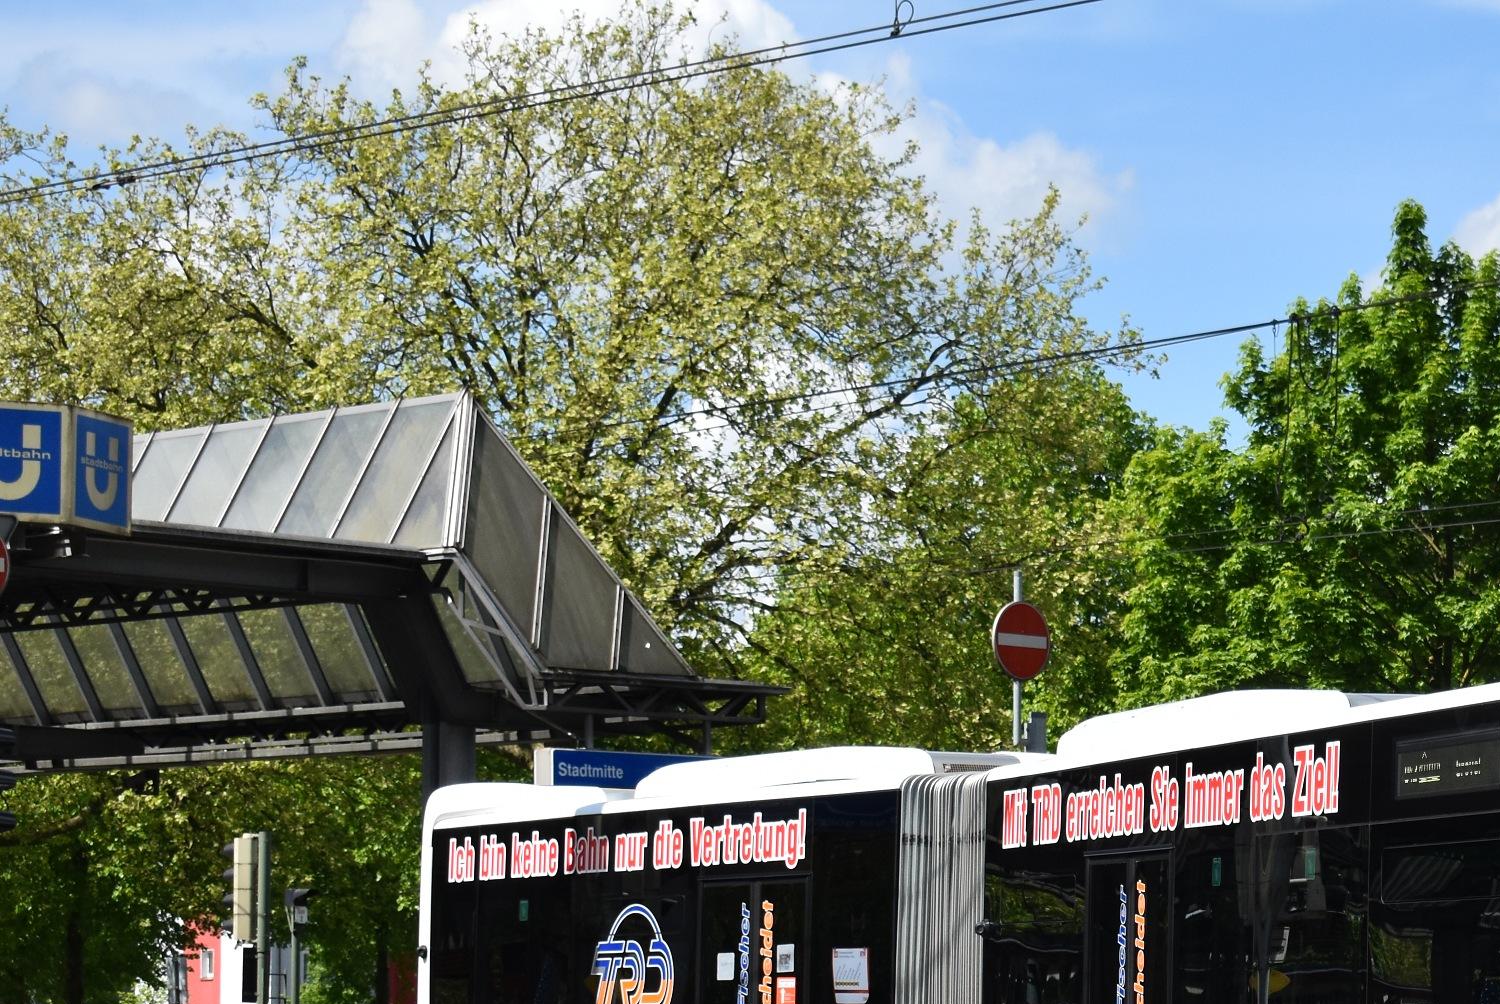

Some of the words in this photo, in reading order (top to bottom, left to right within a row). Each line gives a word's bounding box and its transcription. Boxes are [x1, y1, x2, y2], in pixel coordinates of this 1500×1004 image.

[81, 456, 123, 472] stadtbahn
[558, 762, 624, 779] Stadtmitte
[1002, 788, 1027, 849] Mit
[1032, 782, 1061, 845] TRD
[1065, 773, 1144, 843] erreichen
[1150, 766, 1178, 833] Sie
[1184, 762, 1244, 828] immer
[1250, 752, 1286, 822] das
[1292, 741, 1340, 817] Ziel!
[448, 837, 475, 883] Ich
[479, 834, 505, 880] bin
[511, 831, 558, 879] keine
[564, 827, 609, 874] Bahn
[615, 831, 647, 872] nur
[653, 820, 682, 869] die
[690, 808, 807, 869] Vertretung!
